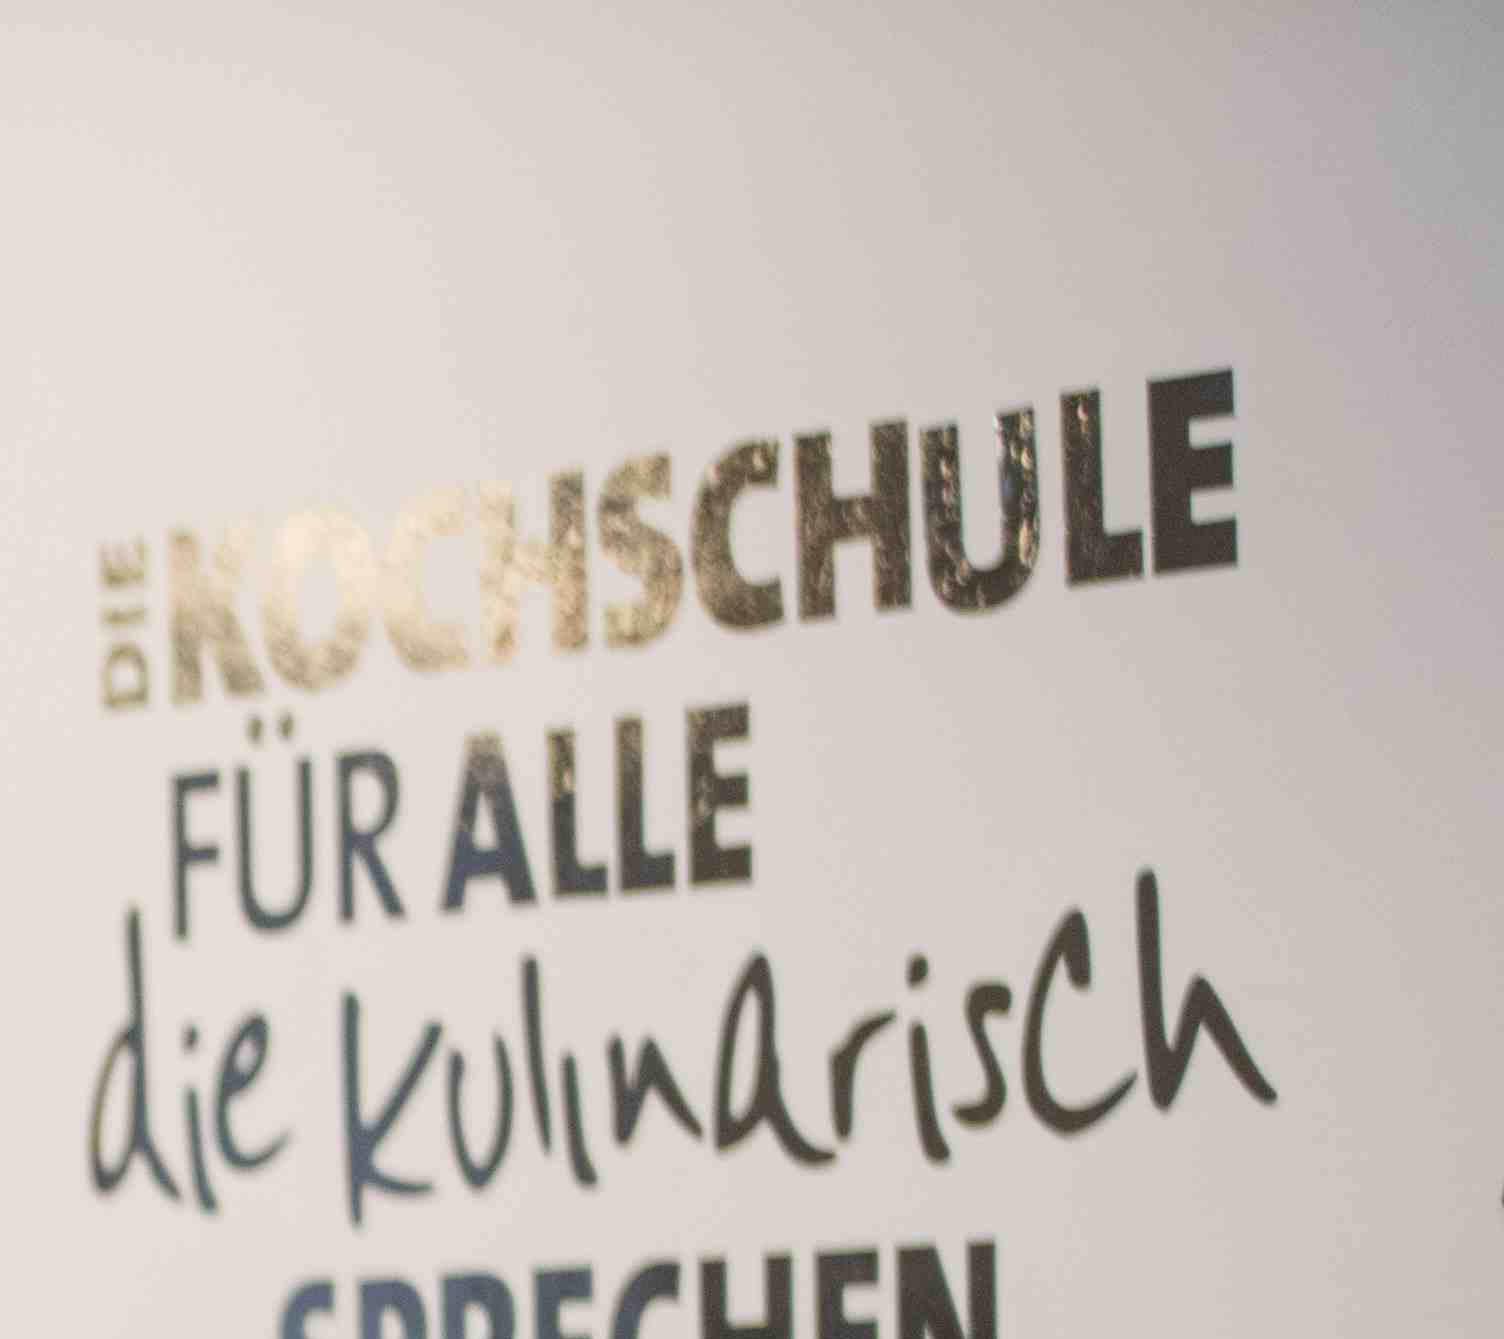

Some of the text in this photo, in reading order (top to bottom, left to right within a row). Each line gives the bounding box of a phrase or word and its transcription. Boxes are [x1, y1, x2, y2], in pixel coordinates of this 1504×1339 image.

[99, 368, 1240, 714] DIE KOCHSCHULE
[169, 700, 754, 942] FÜR ALLE
[88, 904, 292, 1214] die
